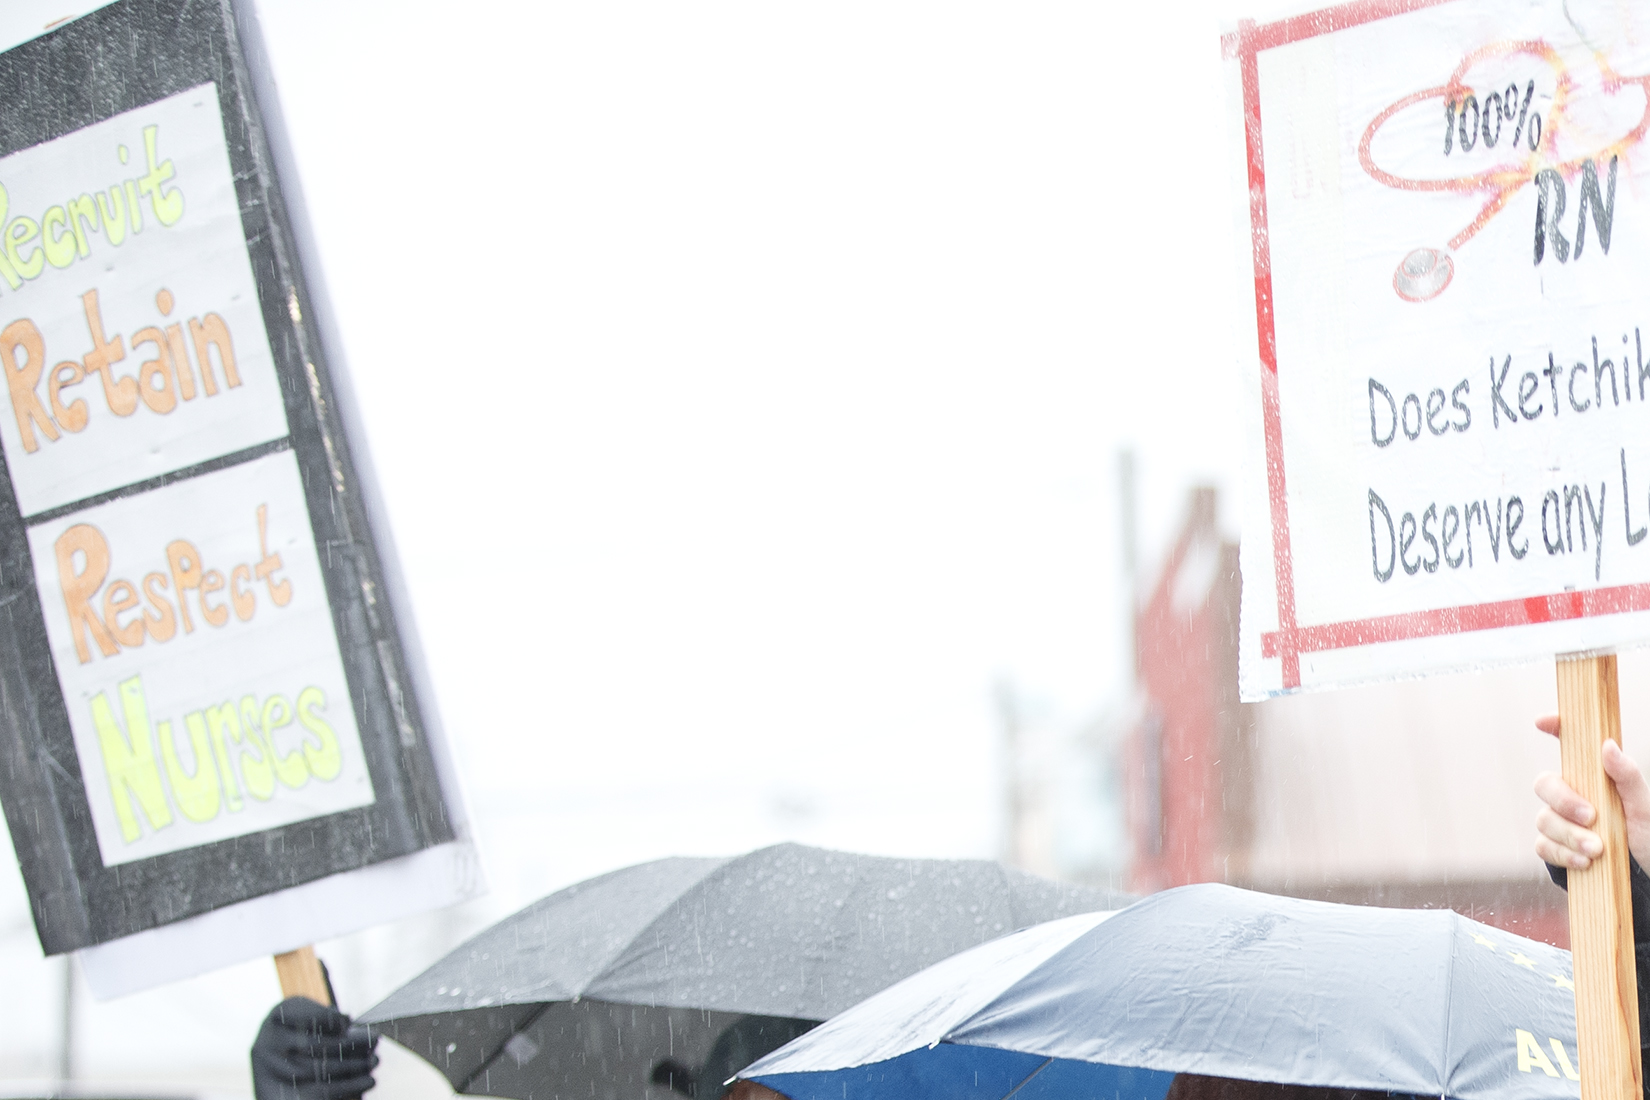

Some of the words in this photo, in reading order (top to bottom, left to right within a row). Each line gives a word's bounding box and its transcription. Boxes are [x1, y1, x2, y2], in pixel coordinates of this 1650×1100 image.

[1441, 78, 1543, 157] 100%
[1533, 155, 1618, 266] RN
[0, 288, 243, 454] Retain
[1367, 377, 1471, 449] Does
[1367, 488, 1527, 583] Deserve
[1541, 473, 1607, 581] any
[90, 675, 343, 846] Nurses
